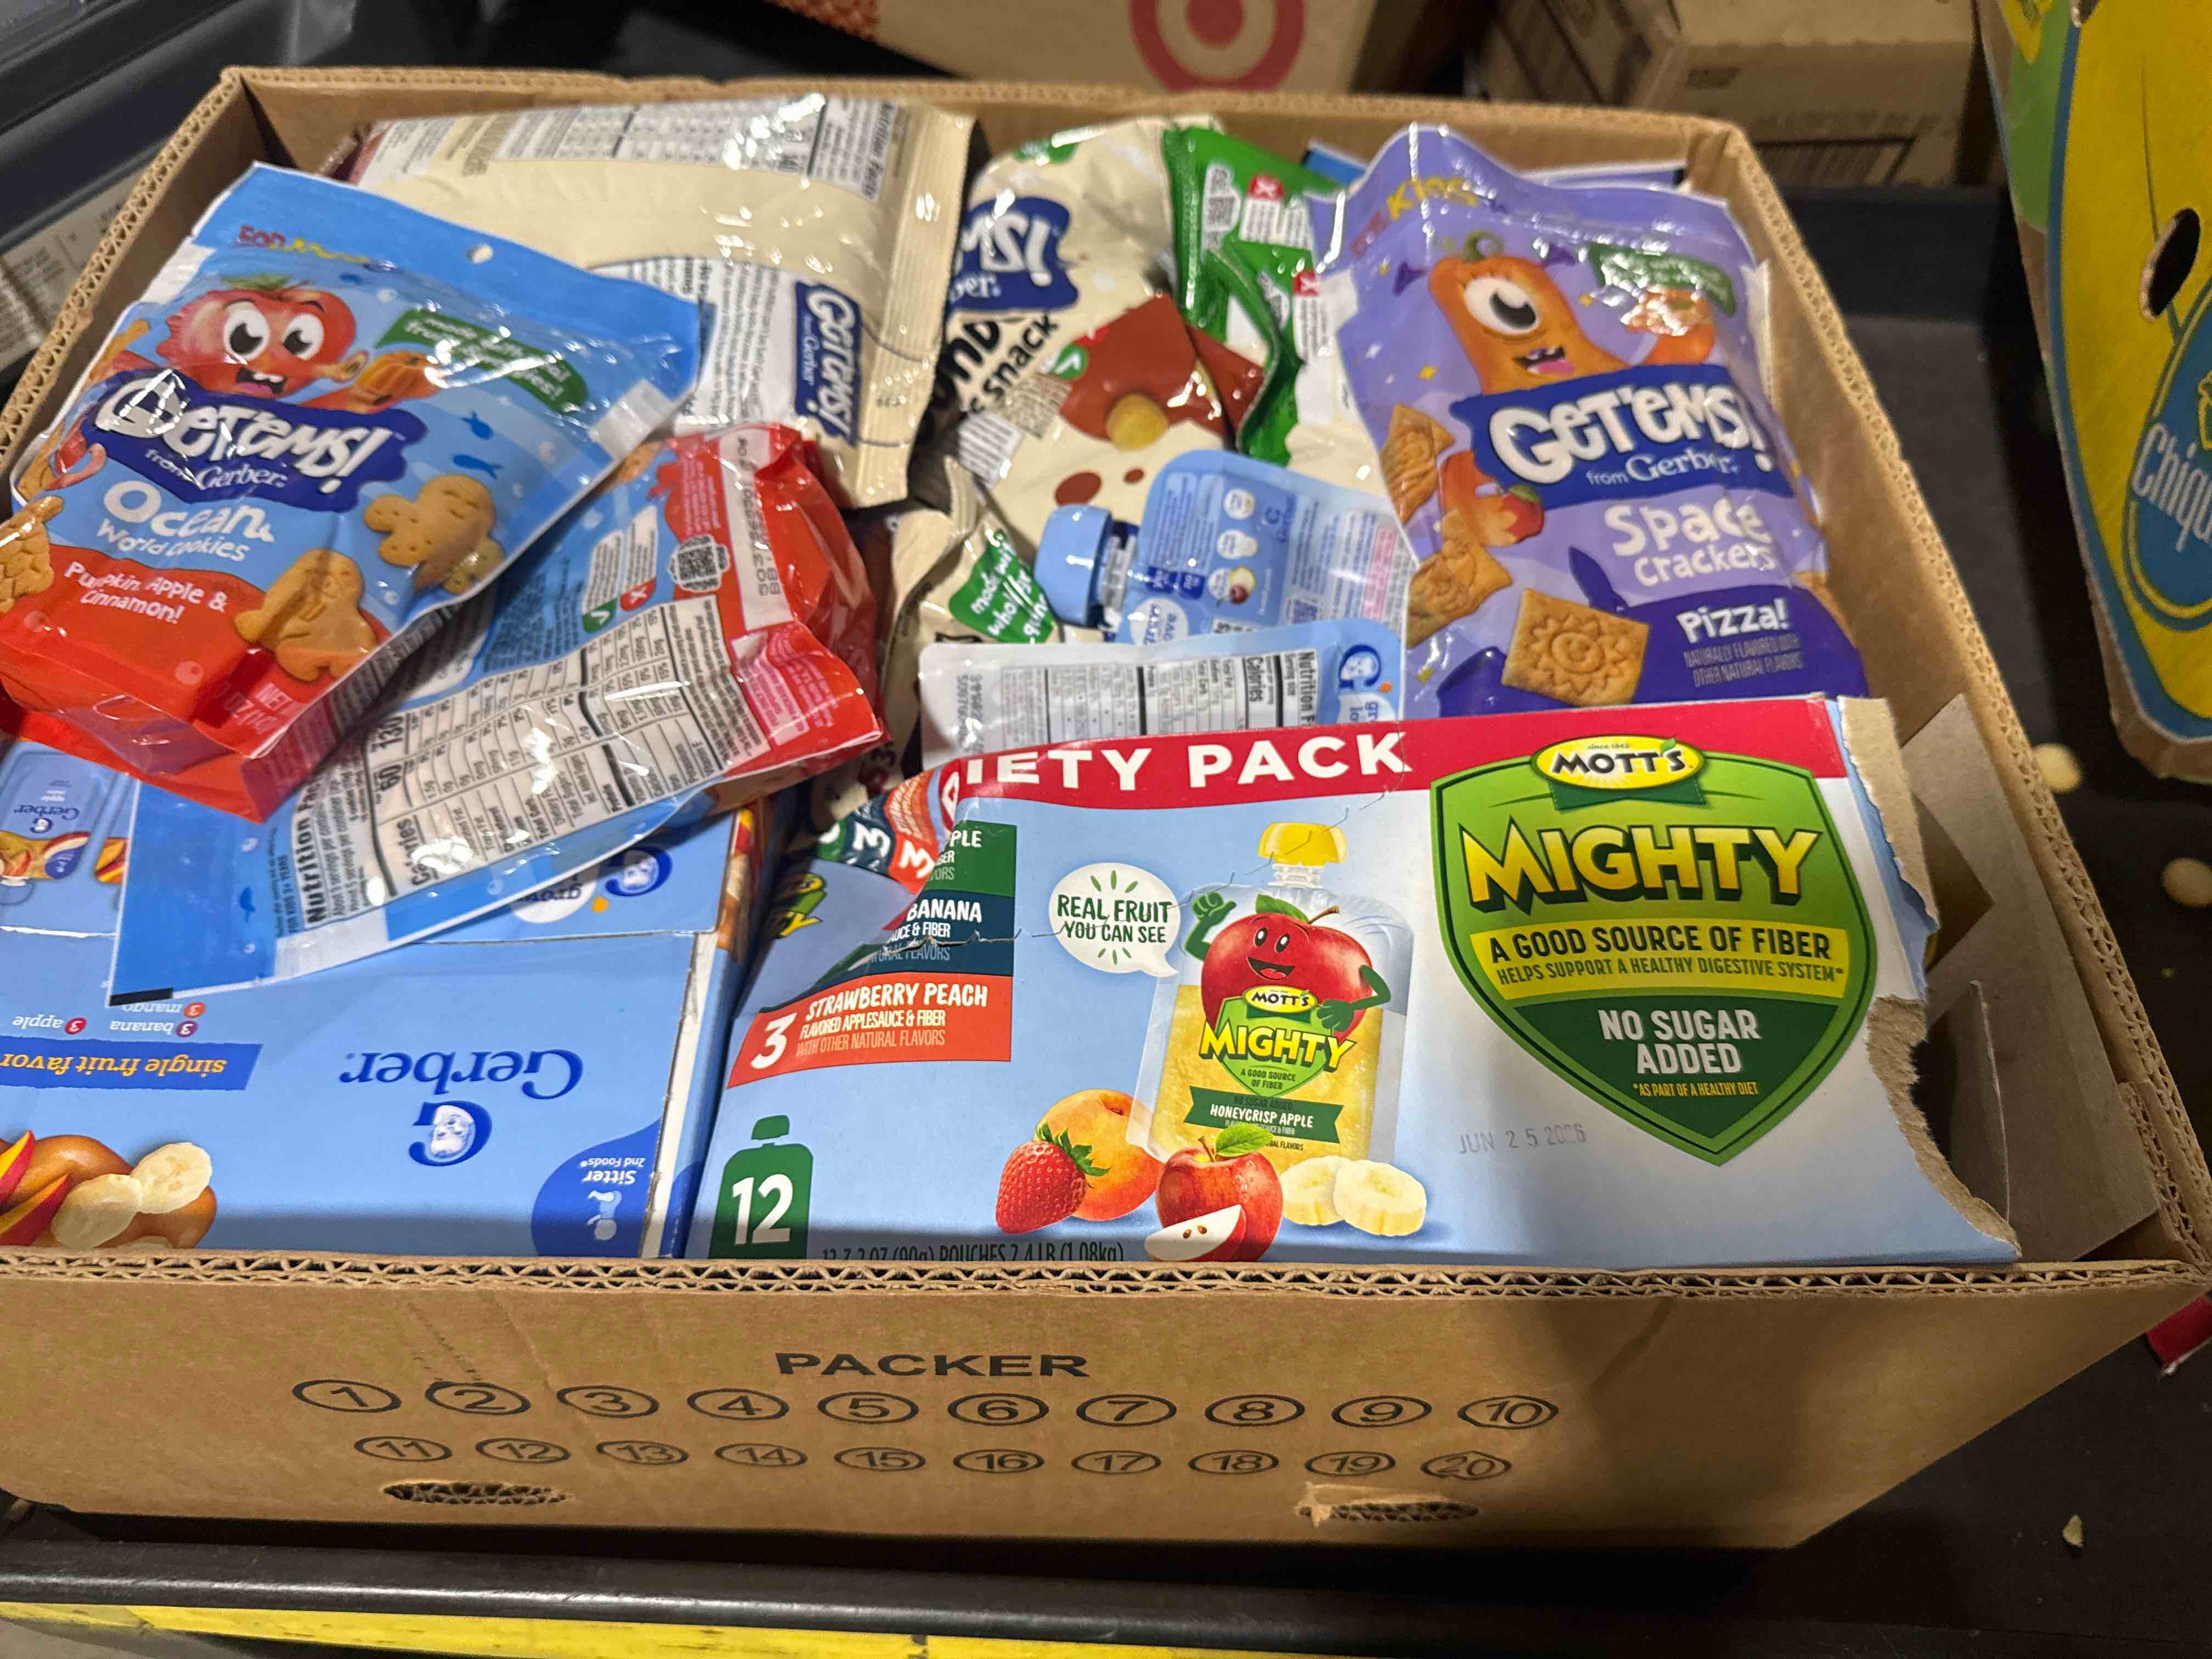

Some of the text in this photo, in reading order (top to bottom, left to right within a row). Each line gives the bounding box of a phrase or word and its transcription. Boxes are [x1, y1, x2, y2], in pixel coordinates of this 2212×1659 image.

[1585, 470, 1628, 486] from
[2132, 422, 2212, 553] Chiqu
[104, 480, 273, 543] Ocean
[1604, 497, 1773, 556] Space
[146, 577, 204, 603] Apple
[208, 591, 228, 613] &
[1677, 597, 1790, 644] Pizza!
[1247, 658, 1264, 702] Calories
[1299, 652, 1316, 710] Nutrition
[966, 731, 1414, 793] IETY PACK
[14, 804, 80, 821] Gerber
[379, 716, 433, 886] Caries 60 130
[296, 783, 327, 923] Nutrition Fac
[950, 831, 983, 848] PLE
[1459, 815, 1822, 913] MIGHTY
[907, 899, 983, 923] BANANA
[1057, 894, 1172, 924] REAL FRUIT
[923, 923, 951, 938] FIBER
[1063, 921, 1167, 944] YOU CAN SEE
[1491, 924, 1831, 963] A GOOD SOURCE OF FIBER
[1498, 964, 1544, 985] HELPS
[1547, 960, 1613, 980] SUPPORT
[1618, 960, 1628, 974] A
[1631, 958, 1694, 974] HEALTHY
[1700, 959, 1773, 977] DIGESTIVE
[805, 983, 988, 1021] STRAWBERRY PEACH
[12, 1014, 64, 1030] apple
[110, 1020, 175, 1035] banana
[799, 1009, 946, 1040] FLAVORED APPLESAUCE & FIBER
[1599, 1008, 1762, 1041] NO SUGAR
[751, 1013, 796, 1069] 3
[820, 1035, 849, 1053] OTHER
[851, 1030, 897, 1049] NATURAL
[899, 1029, 946, 1047] FLAVORS
[1199, 1019, 1357, 1071] MIGHTY
[0, 1053, 227, 1077] single fruit favor
[1637, 1044, 1742, 1075] ADDED
[1248, 1070, 1266, 1079] GOOD
[1268, 1072, 1296, 1081] SOURCE
[1262, 1081, 1283, 1090] FIBER
[1652, 1083, 1675, 1097] PART
[1677, 1084, 1689, 1097] OF
[1690, 1084, 1697, 1096] A
[1699, 1083, 1736, 1096] HEALTHY
[1737, 1082, 1759, 1096] DIET
[1210, 1104, 1277, 1124] HONEYCRISP
[1279, 1113, 1313, 1128] APPLE
[1458, 1133, 1496, 1155] JUN
[623, 1157, 646, 1168] 2nd
[582, 1170, 637, 1186] Sitter
[732, 1173, 795, 1244] 12
[940, 1244, 1006, 1261] POUCHES
[776, 1352, 1090, 1376] PACKER
[457, 1390, 506, 1411] 2
[582, 1392, 634, 1414] 3
[718, 1393, 762, 1417] 4
[848, 1397, 887, 1420] 5
[978, 1400, 1018, 1420] 6
[1108, 1400, 1149, 1422] 7
[1232, 1400, 1274, 1422] 8
[1361, 1401, 1404, 1423] 9
[1485, 1398, 1543, 1424] 10
[377, 1440, 1495, 1479] 11 12 13 14 15 16 17 18 19 20
